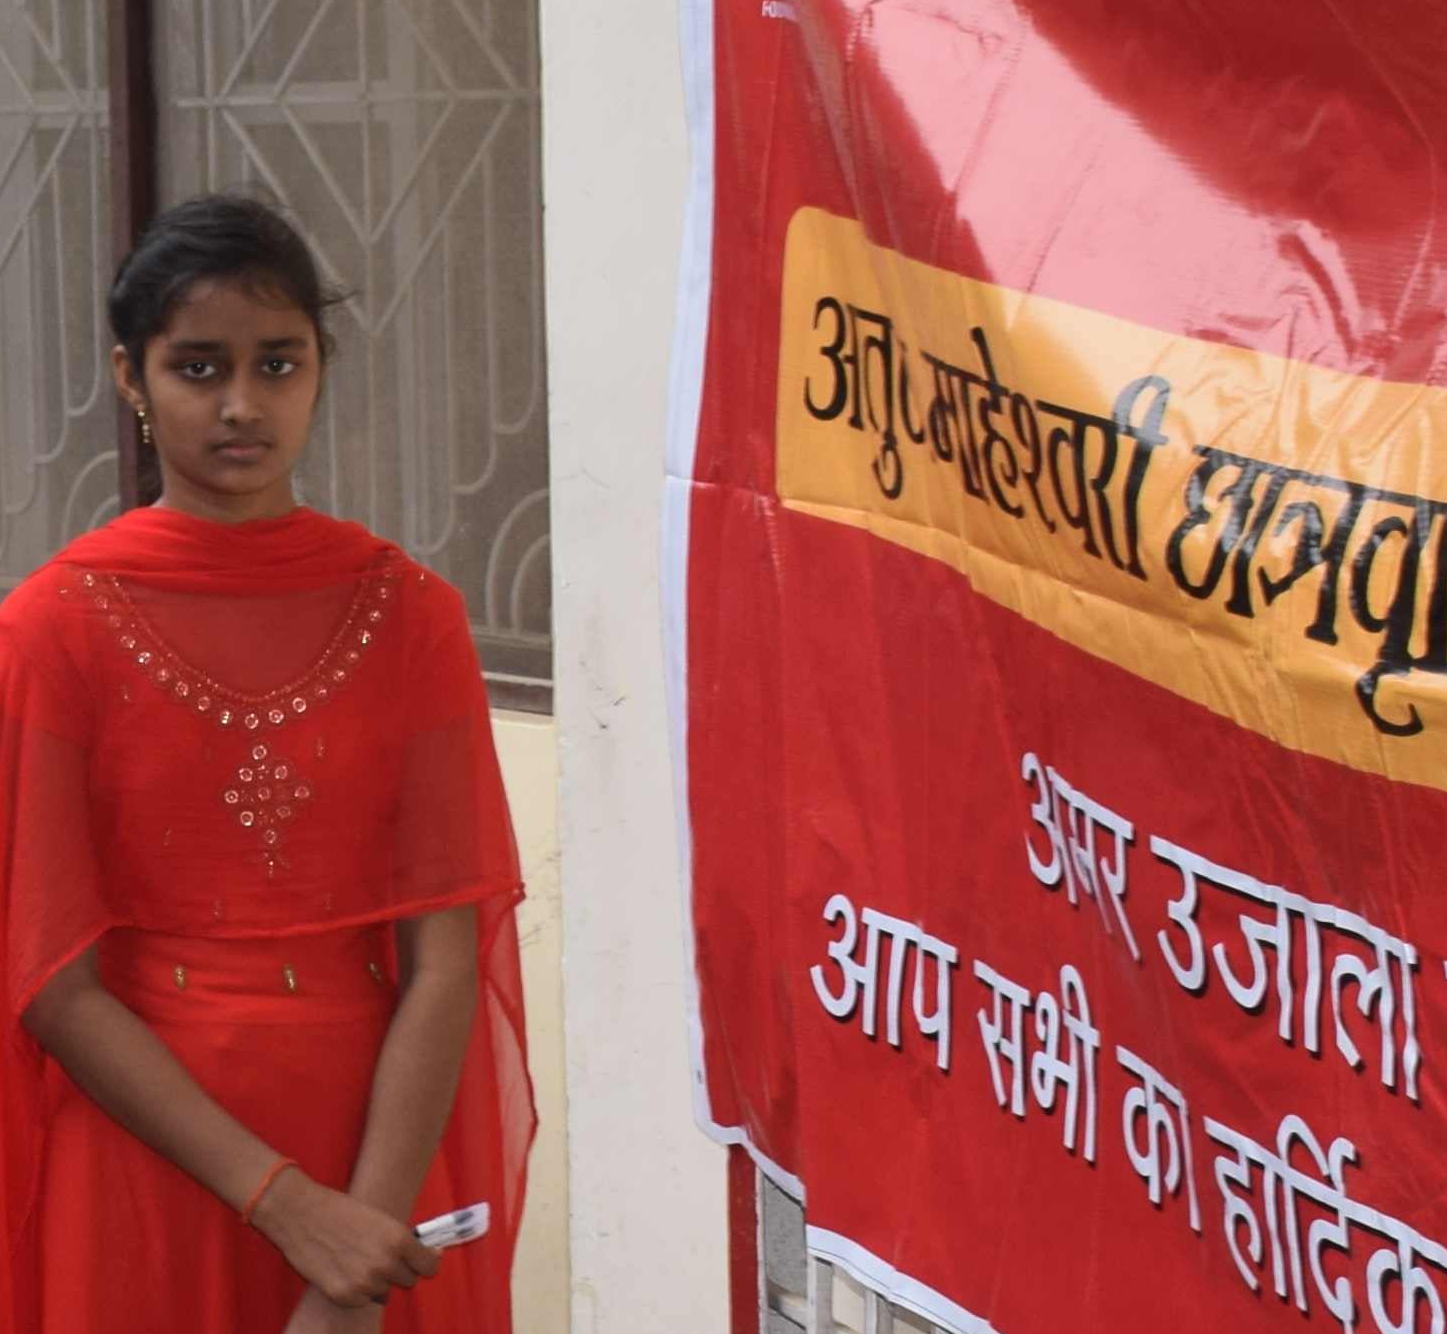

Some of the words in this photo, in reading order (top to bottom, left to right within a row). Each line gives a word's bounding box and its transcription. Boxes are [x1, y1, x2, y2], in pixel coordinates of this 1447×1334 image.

[920, 325, 1168, 582] माहेश्वरी
[809, 893, 958, 1071] आप
[973, 963, 1102, 1164] सभी
[1114, 1044, 1203, 1234] का
[1020, 751, 1142, 962] अमर
[1149, 833, 1419, 1101] उजाला
